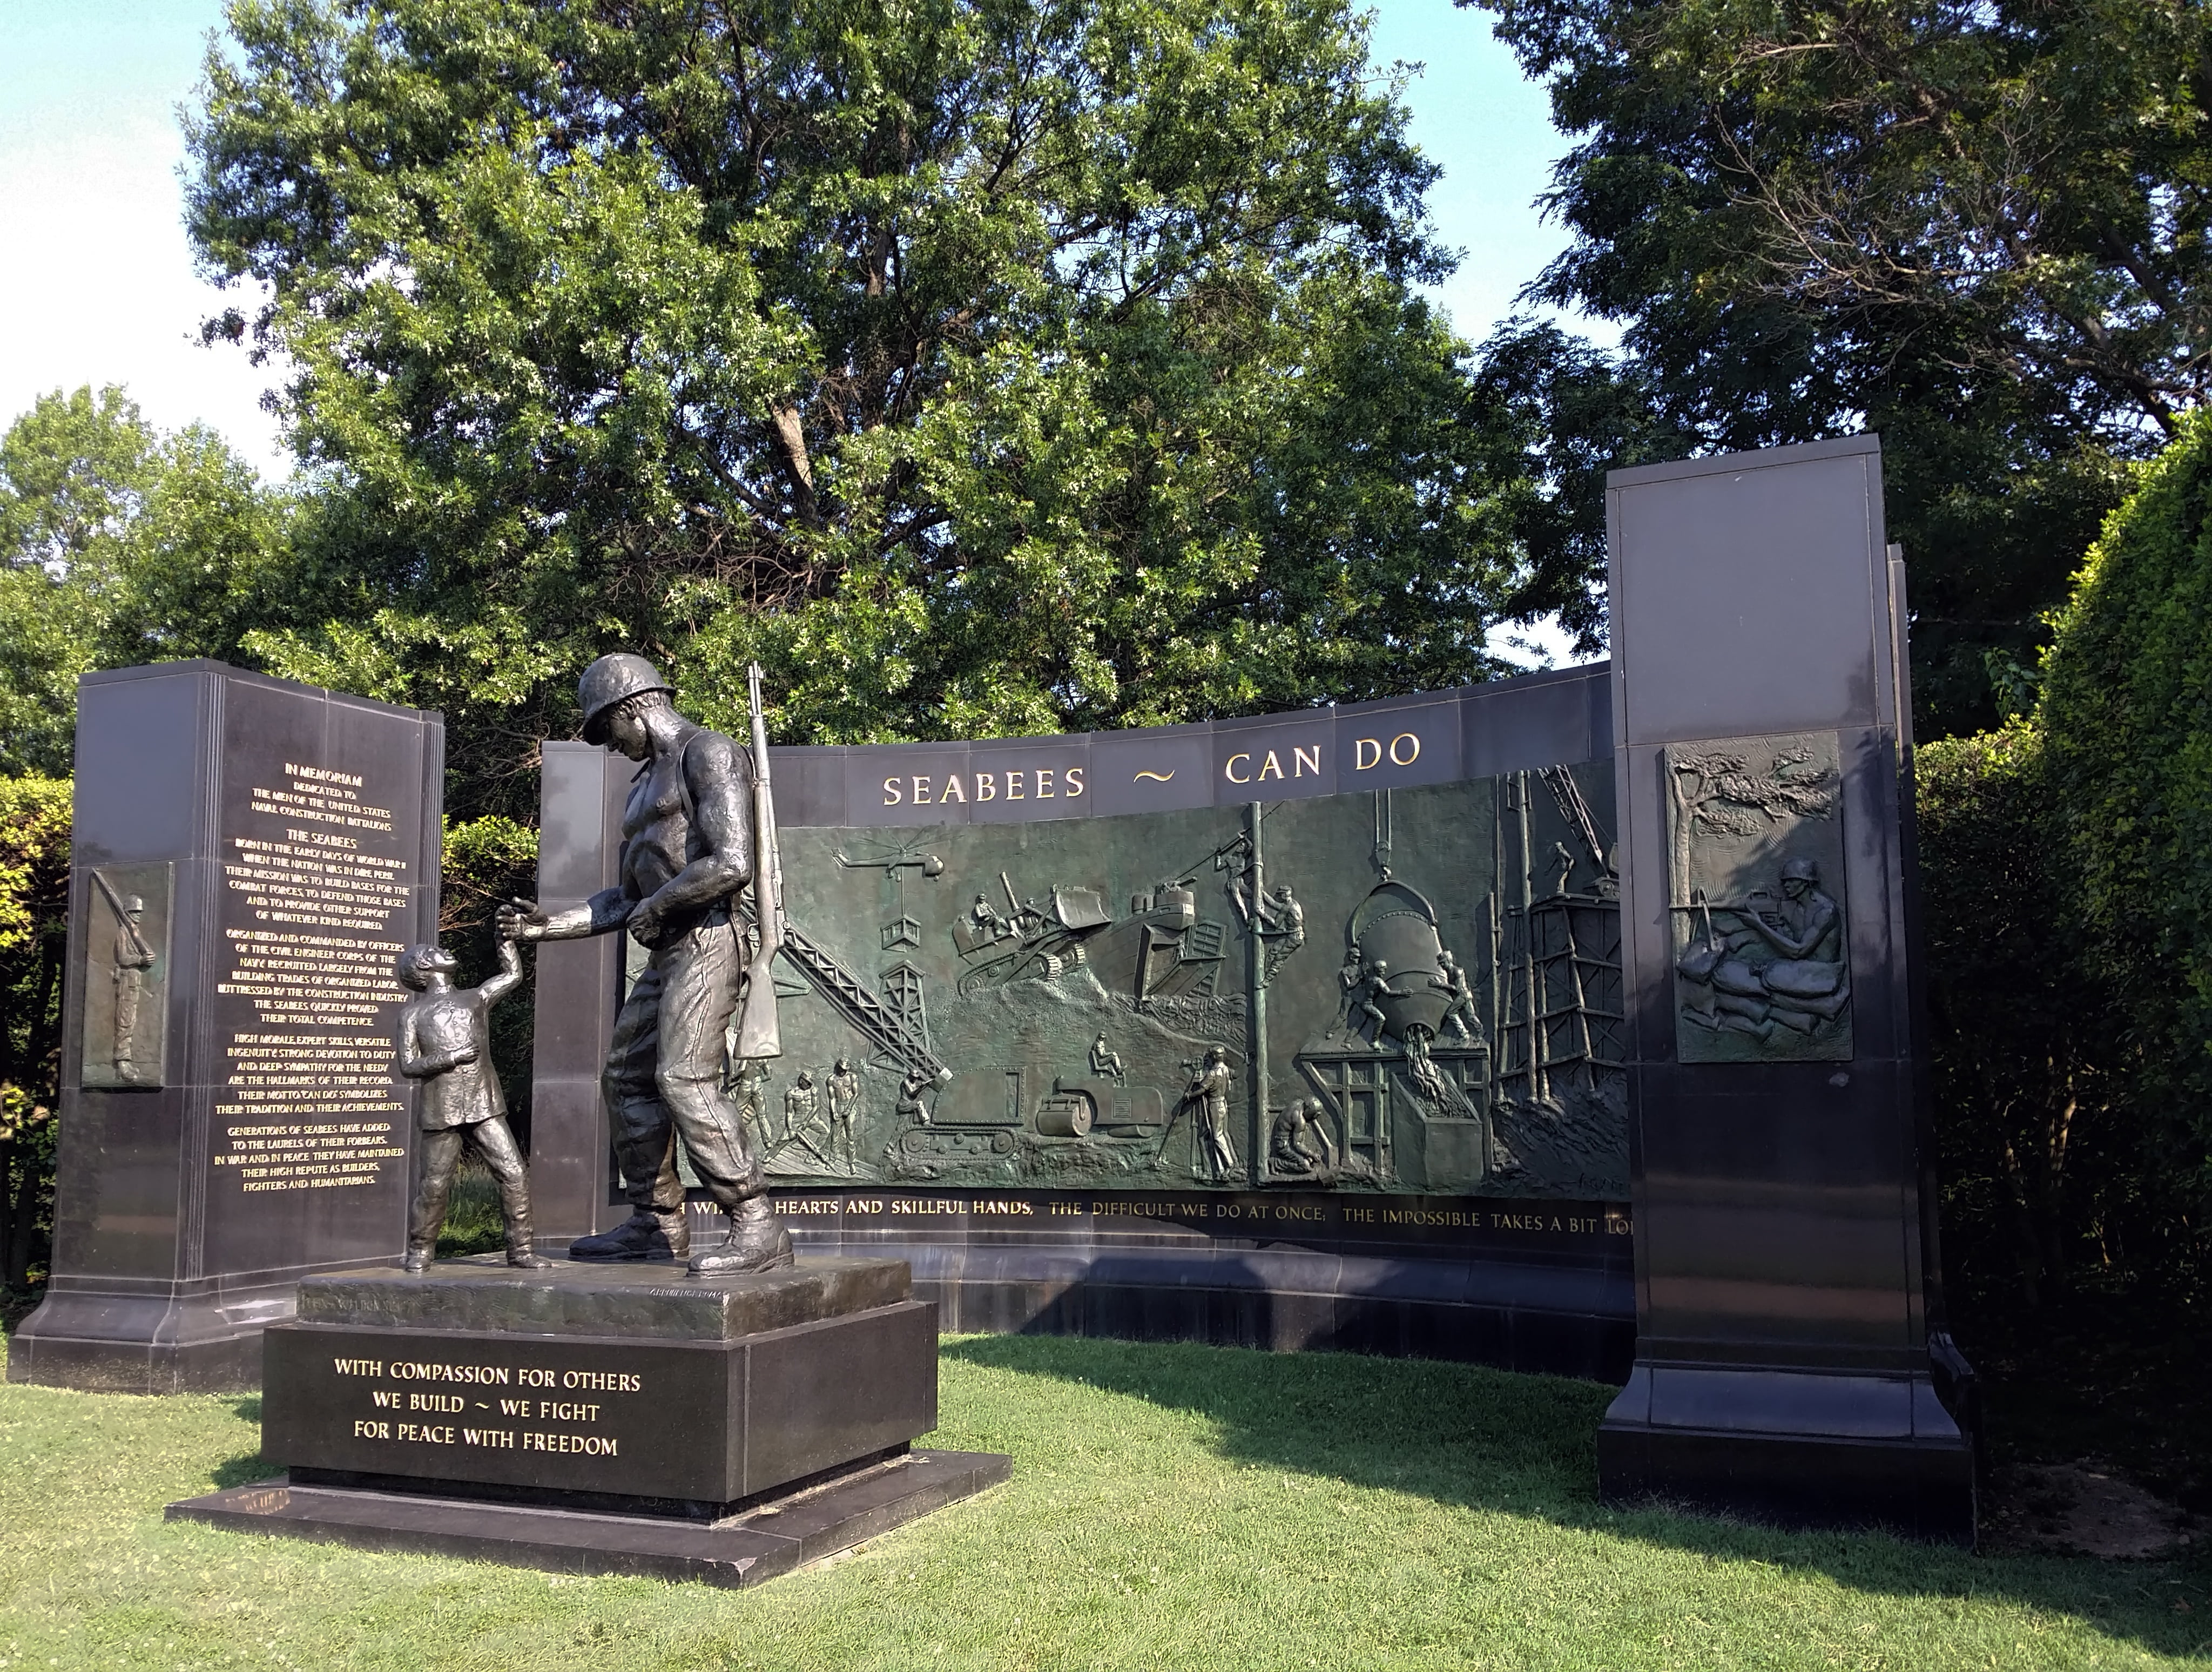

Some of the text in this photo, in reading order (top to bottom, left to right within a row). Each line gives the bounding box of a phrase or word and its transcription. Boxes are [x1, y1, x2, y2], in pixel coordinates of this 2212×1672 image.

[285, 763, 362, 787] IN MEMORIAM
[884, 732, 1420, 805] SEABEES CAN DO
[293, 781, 356, 800] DEDICATED TO
[252, 787, 390, 818] THE MEN OF THE UNITED STATES
[251, 801, 391, 831] NAVAL CONSTRUCTION BATTALIONS
[286, 828, 356, 848] THE SEABEES
[235, 838, 400, 868] BORN IN THE EARLY DAYS OF WAR
[242, 853, 353, 875] WHEN THE NATION WAS IN
[225, 866, 409, 895] THEIR MISSION WAS TO BASES FOR THE
[305, 888, 406, 907] TO DEFEND THOSE BASES
[246, 896, 389, 918] AND TO OTHER SUPPORT
[255, 910, 341, 926] OF WHATEVER KIND
[226, 928, 404, 952] ORGANIZED AND COMMANDED OFFICERS
[235, 943, 396, 963] OF THE ENGINEER CORPS OF THE
[267, 960, 393, 976] RECRUITED THE
[232, 971, 371, 987] BUILDING TRADES OF ORGANIZED
[286, 987, 408, 1002] THE CONSTRUCTION INDUSTRY
[253, 999, 308, 1010] THE SEABEES
[260, 1013, 315, 1024] THEIR TOTAL
[234, 1034, 391, 1046] HIGH EXPERT VERSATILE
[279, 1049, 396, 1059] STRONG DEVOTION TO DUTY
[237, 1062, 388, 1072] AND DEEP SYMPATHY FOR THE NEEDY
[228, 1076, 358, 1086] ARE THE HALLMARKS OF THEIR
[237, 1090, 301, 1100] THEIR MOTTO
[215, 1103, 341, 1114] THEIR TRADITION AND THEIR
[227, 1123, 390, 1136] GENERATIONS OF SEABEES HAVE ADDED
[232, 1140, 246, 1150] TO
[247, 1140, 265, 1149] THE
[267, 1138, 304, 1149] LAURELS
[305, 1138, 318, 1147] OF
[320, 1137, 345, 1147] THEIR
[214, 1148, 404, 1165] IN WAR AND IN PEACE THEY HAVE MAINTAINED
[241, 1168, 268, 1177] THEIR
[269, 1167, 293, 1176] HIGH
[295, 1164, 328, 1175] REPUTE
[329, 1164, 340, 1173] AS
[243, 1181, 287, 1191] FIGHTERS
[288, 1179, 308, 1189] AND
[775, 1201, 839, 1214] HEARTS
[846, 1201, 883, 1213] AND
[892, 1201, 967, 1214] SKILLFUL
[973, 1201, 1033, 1215] HANDS,
[1049, 1202, 1082, 1215] THE
[1092, 1202, 1175, 1216] DIFFICULT
[1181, 1204, 1208, 1216] WE
[1217, 1205, 1240, 1218] DO
[1248, 1206, 1269, 1218] AT
[1343, 1208, 1374, 1222] THE
[1383, 1210, 1480, 1226] IMPOSSIBLE
[1491, 1214, 1543, 1230] TAKES
[1550, 1217, 1562, 1231] A
[1569, 1217, 1597, 1232] BIT
[334, 1358, 640, 1391] WITH COMPASSION FOR OTHERS
[373, 1391, 599, 1421] WE BUILD WE FIGHT
[354, 1420, 617, 1455] FOR PEACE WITH FREEDOM
